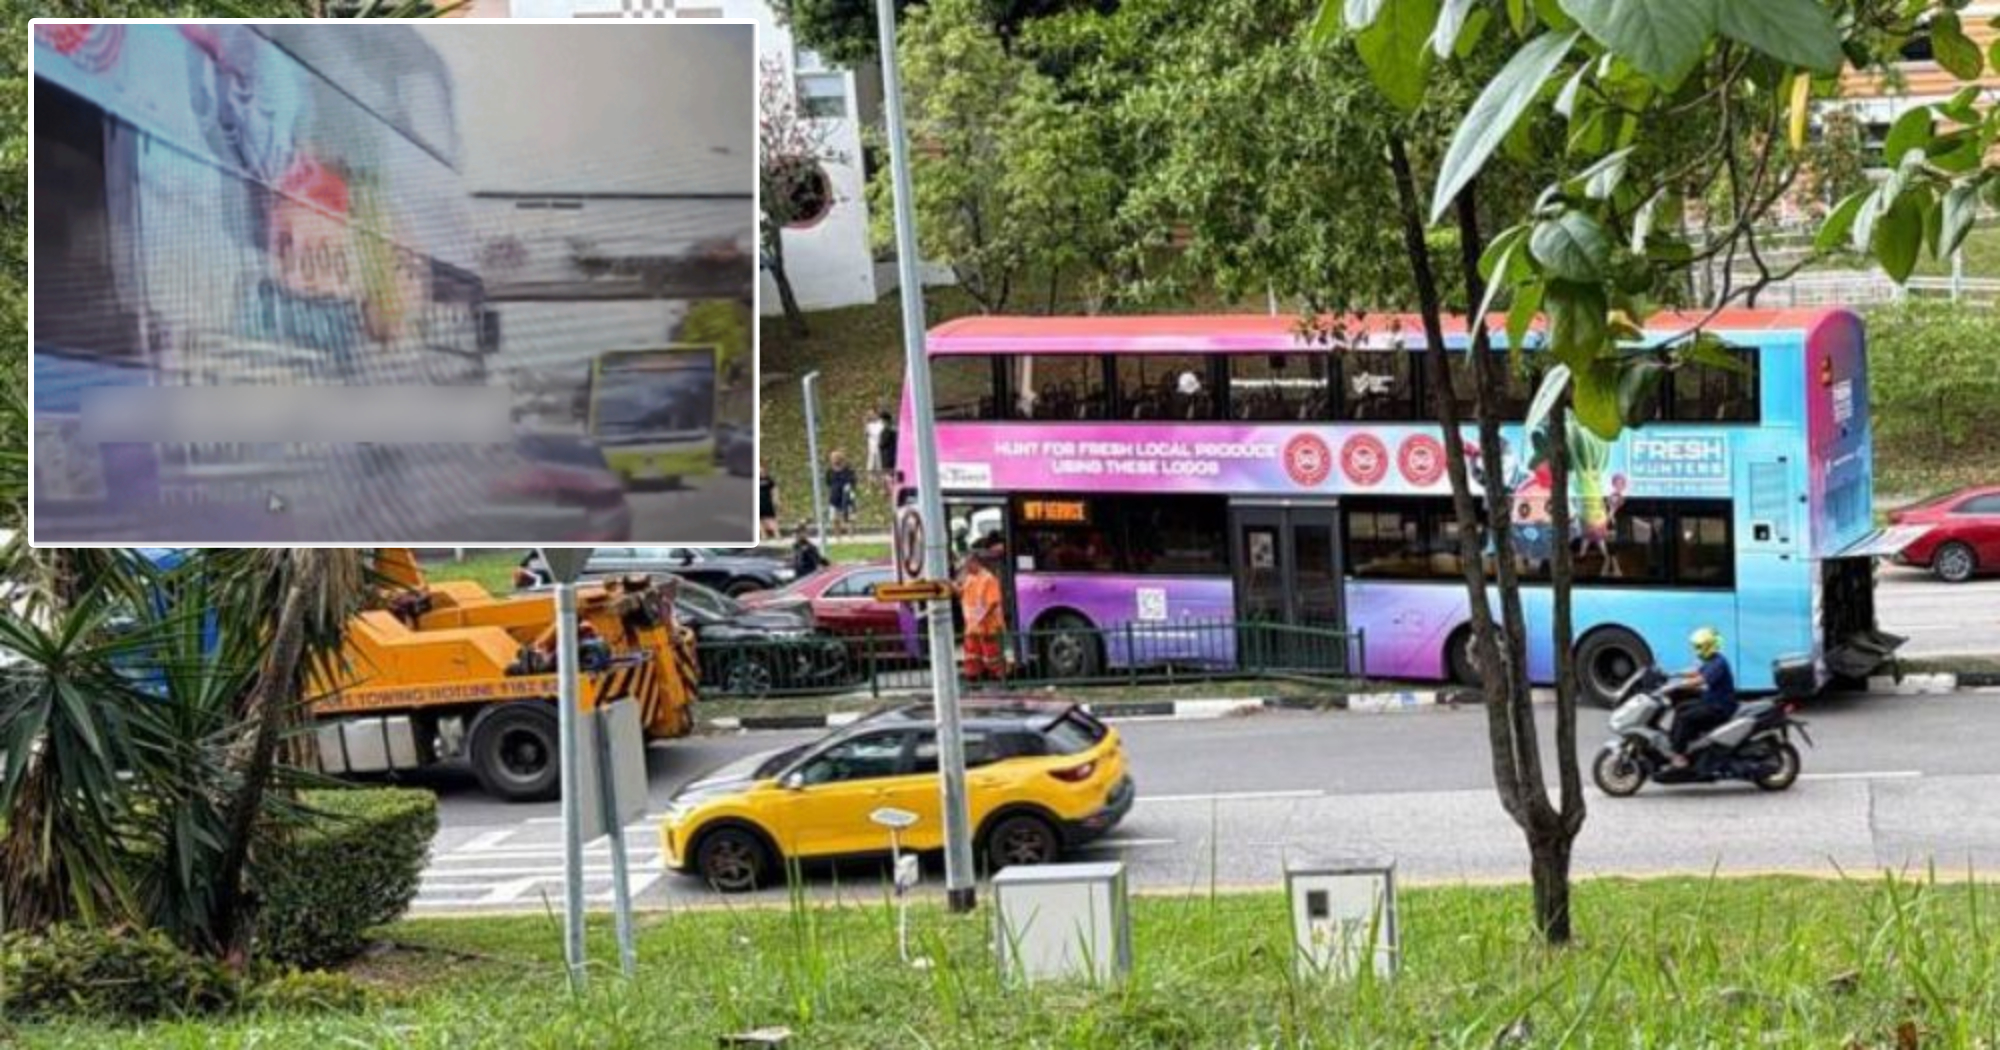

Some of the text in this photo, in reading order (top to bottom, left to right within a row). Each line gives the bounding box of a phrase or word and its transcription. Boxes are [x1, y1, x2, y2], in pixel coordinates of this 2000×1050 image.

[995, 442, 1277, 458] HUNT FOR FRESH LOCAL PRODUCE
[1633, 440, 1722, 459] FRESH
[1053, 460, 1221, 476] USING THESE LOGOS
[1633, 461, 1723, 475] HUNTERS
[358, 688, 424, 707] TOWING
[430, 684, 494, 702] HOTLINE
